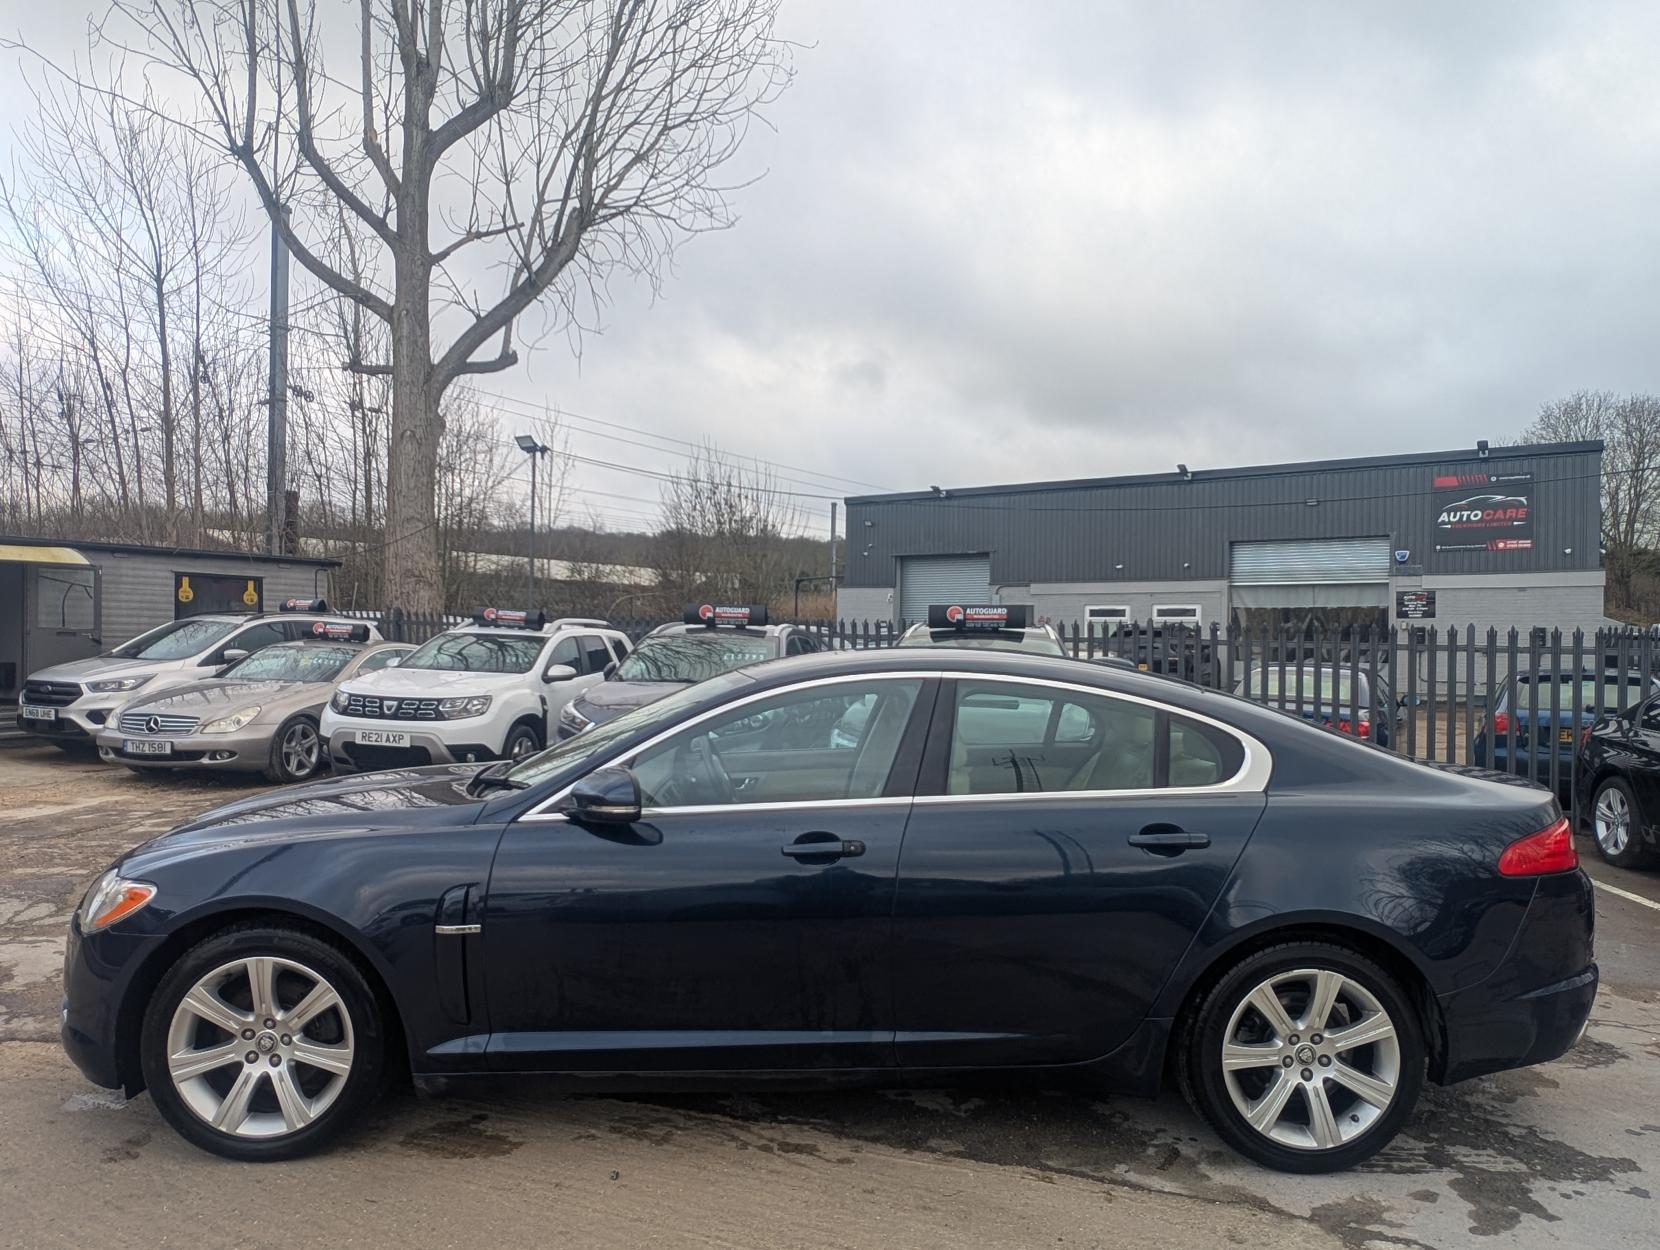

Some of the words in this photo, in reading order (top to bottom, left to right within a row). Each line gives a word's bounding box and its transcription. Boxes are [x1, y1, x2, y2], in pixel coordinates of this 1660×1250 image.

[1438, 509, 1527, 523] AUTOCARE
[715, 606, 750, 614] AUTOGUARD
[965, 607, 1007, 615] AUTOGUARD
[361, 732, 383, 743] RE21
[385, 733, 404, 744] AXP
[131, 742, 146, 752] THZ
[148, 742, 166, 753] 1581
